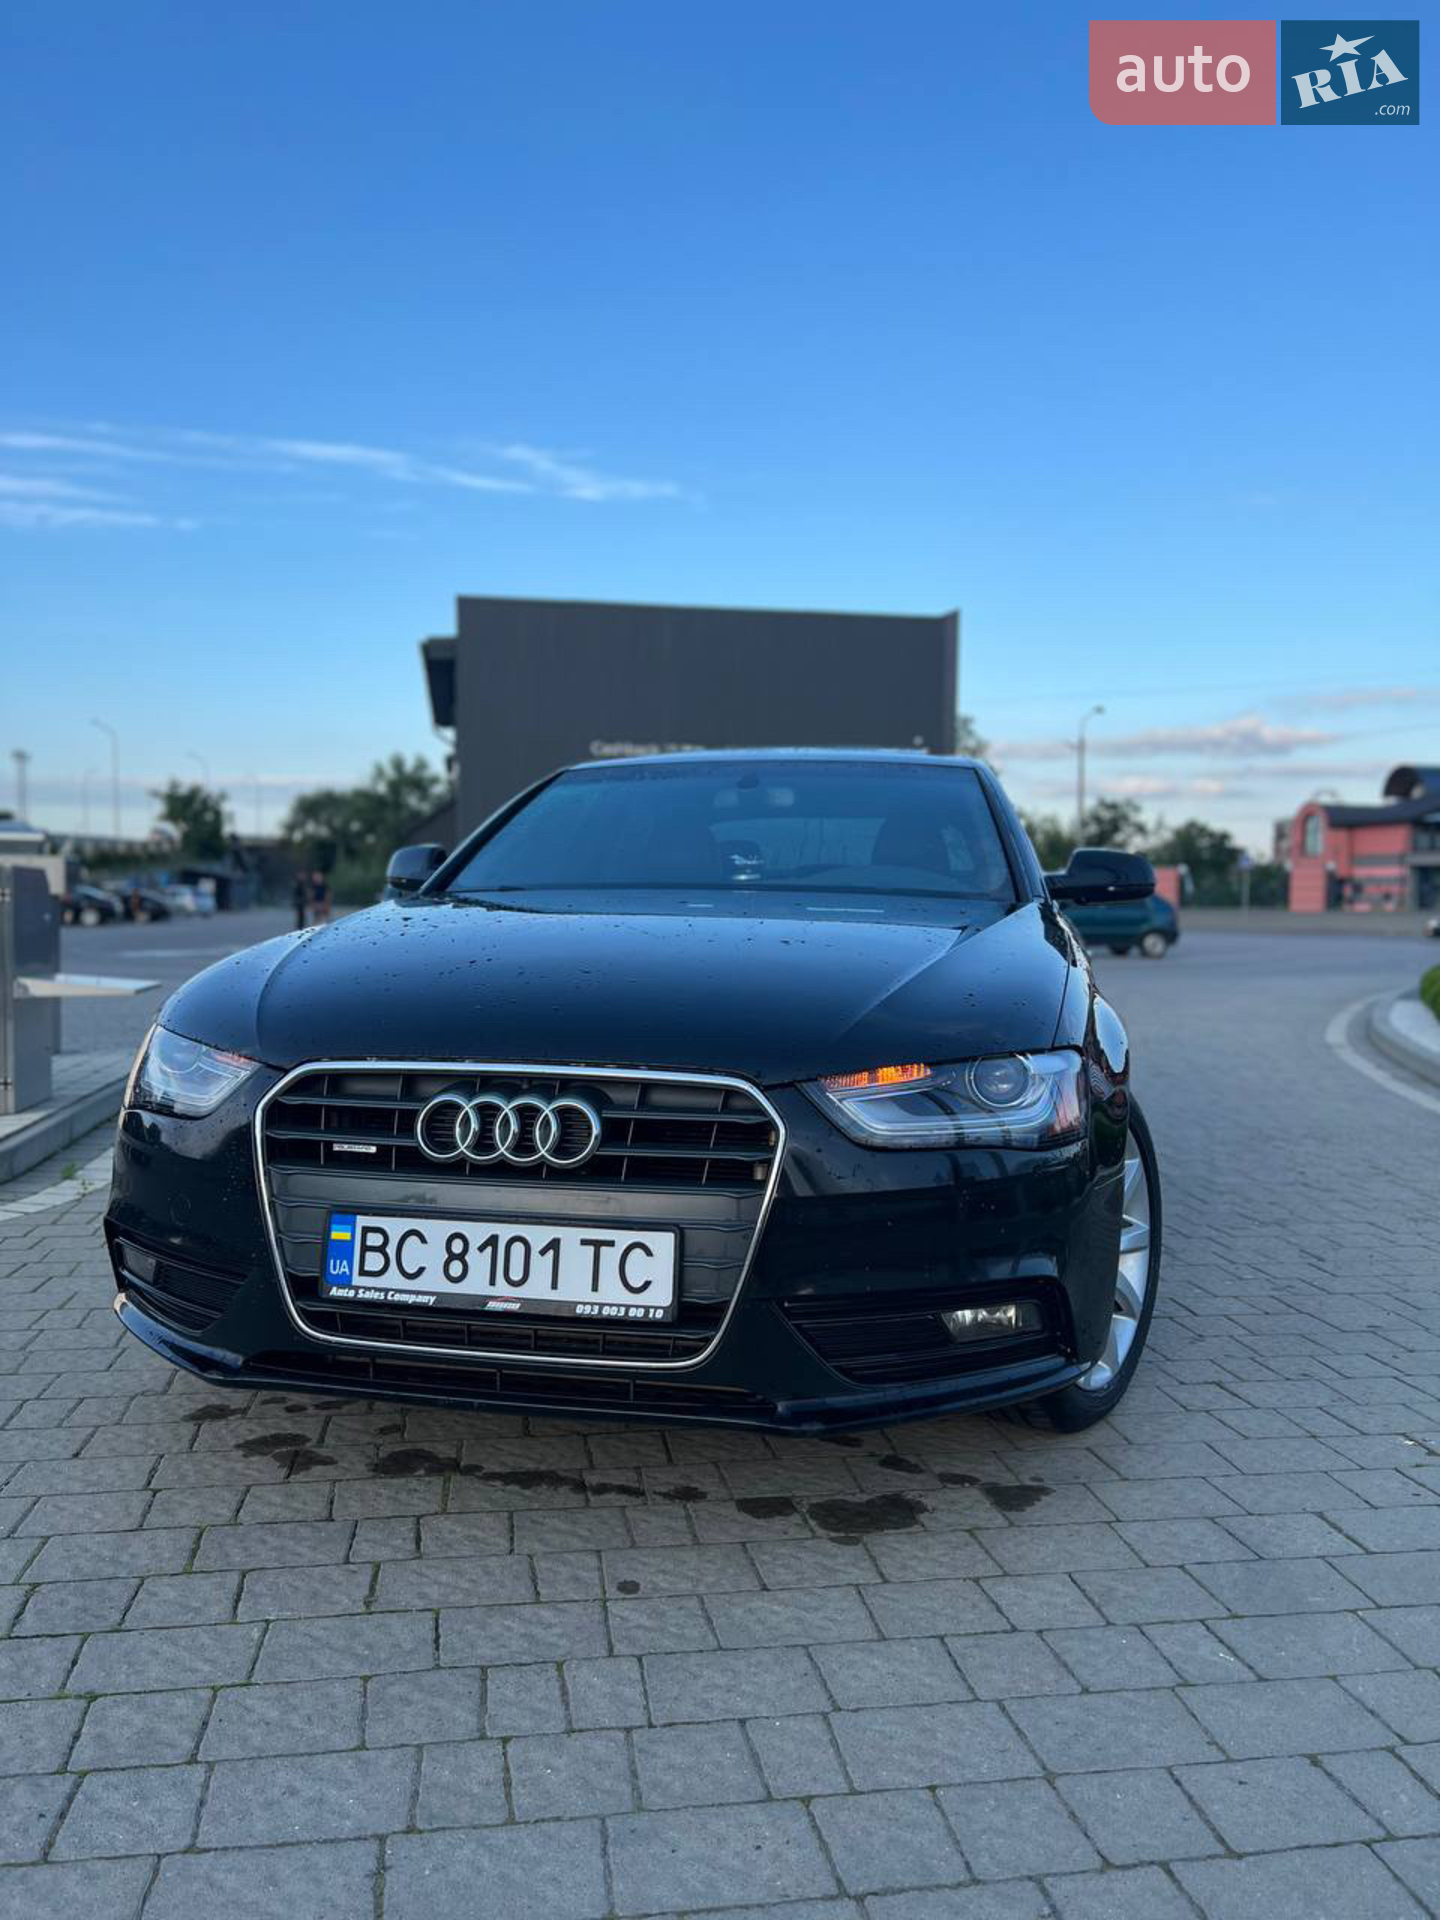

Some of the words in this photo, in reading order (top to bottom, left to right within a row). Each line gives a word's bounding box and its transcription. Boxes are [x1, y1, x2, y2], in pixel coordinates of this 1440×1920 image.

[329, 1259, 350, 1276] UA
[357, 1225, 429, 1281] BC
[442, 1231, 562, 1291] 8101
[579, 1238, 655, 1294] TC
[329, 1286, 356, 1297] Auto
[357, 1289, 385, 1300] Sales
[387, 1291, 436, 1306] Company
[575, 1304, 600, 1315] 093
[648, 1308, 664, 1319] 10
